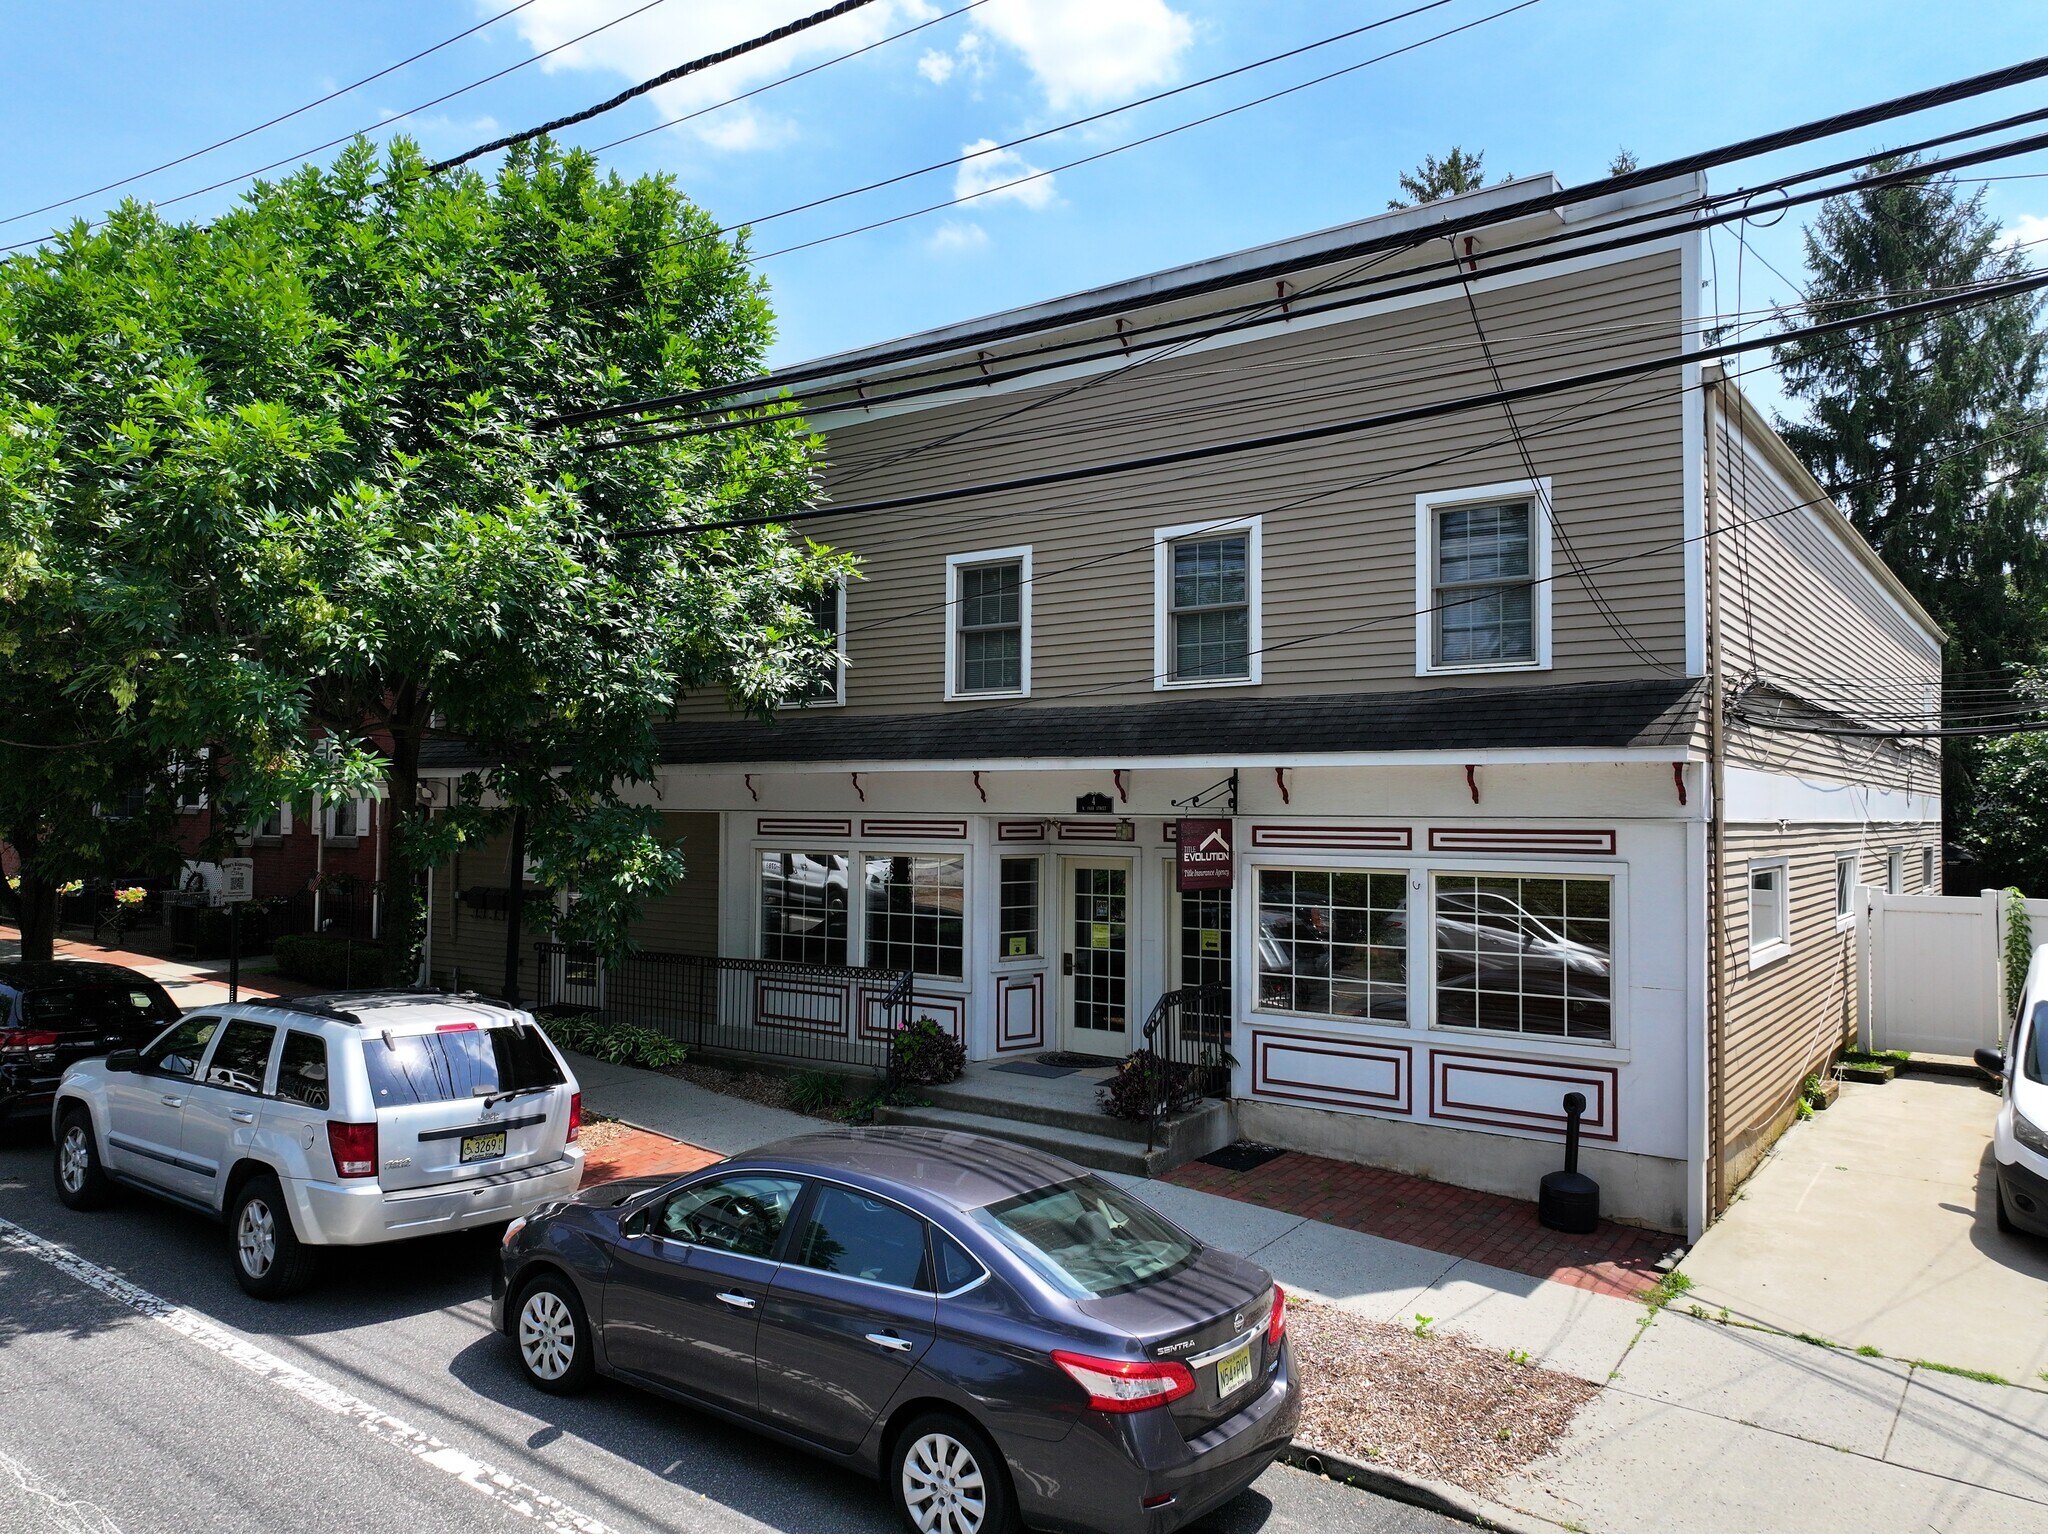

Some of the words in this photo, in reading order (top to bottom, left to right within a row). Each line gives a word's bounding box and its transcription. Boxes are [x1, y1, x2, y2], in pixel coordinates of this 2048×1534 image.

[1184, 845, 1196, 853] TITLE
[1184, 852, 1230, 862] EVOLUTION
[1184, 869, 1194, 877] Title
[1215, 869, 1230, 877] Agency
[477, 1112, 500, 1122] Jeep
[474, 1139, 497, 1154] 3269
[1157, 1340, 1196, 1356] SENTRA
